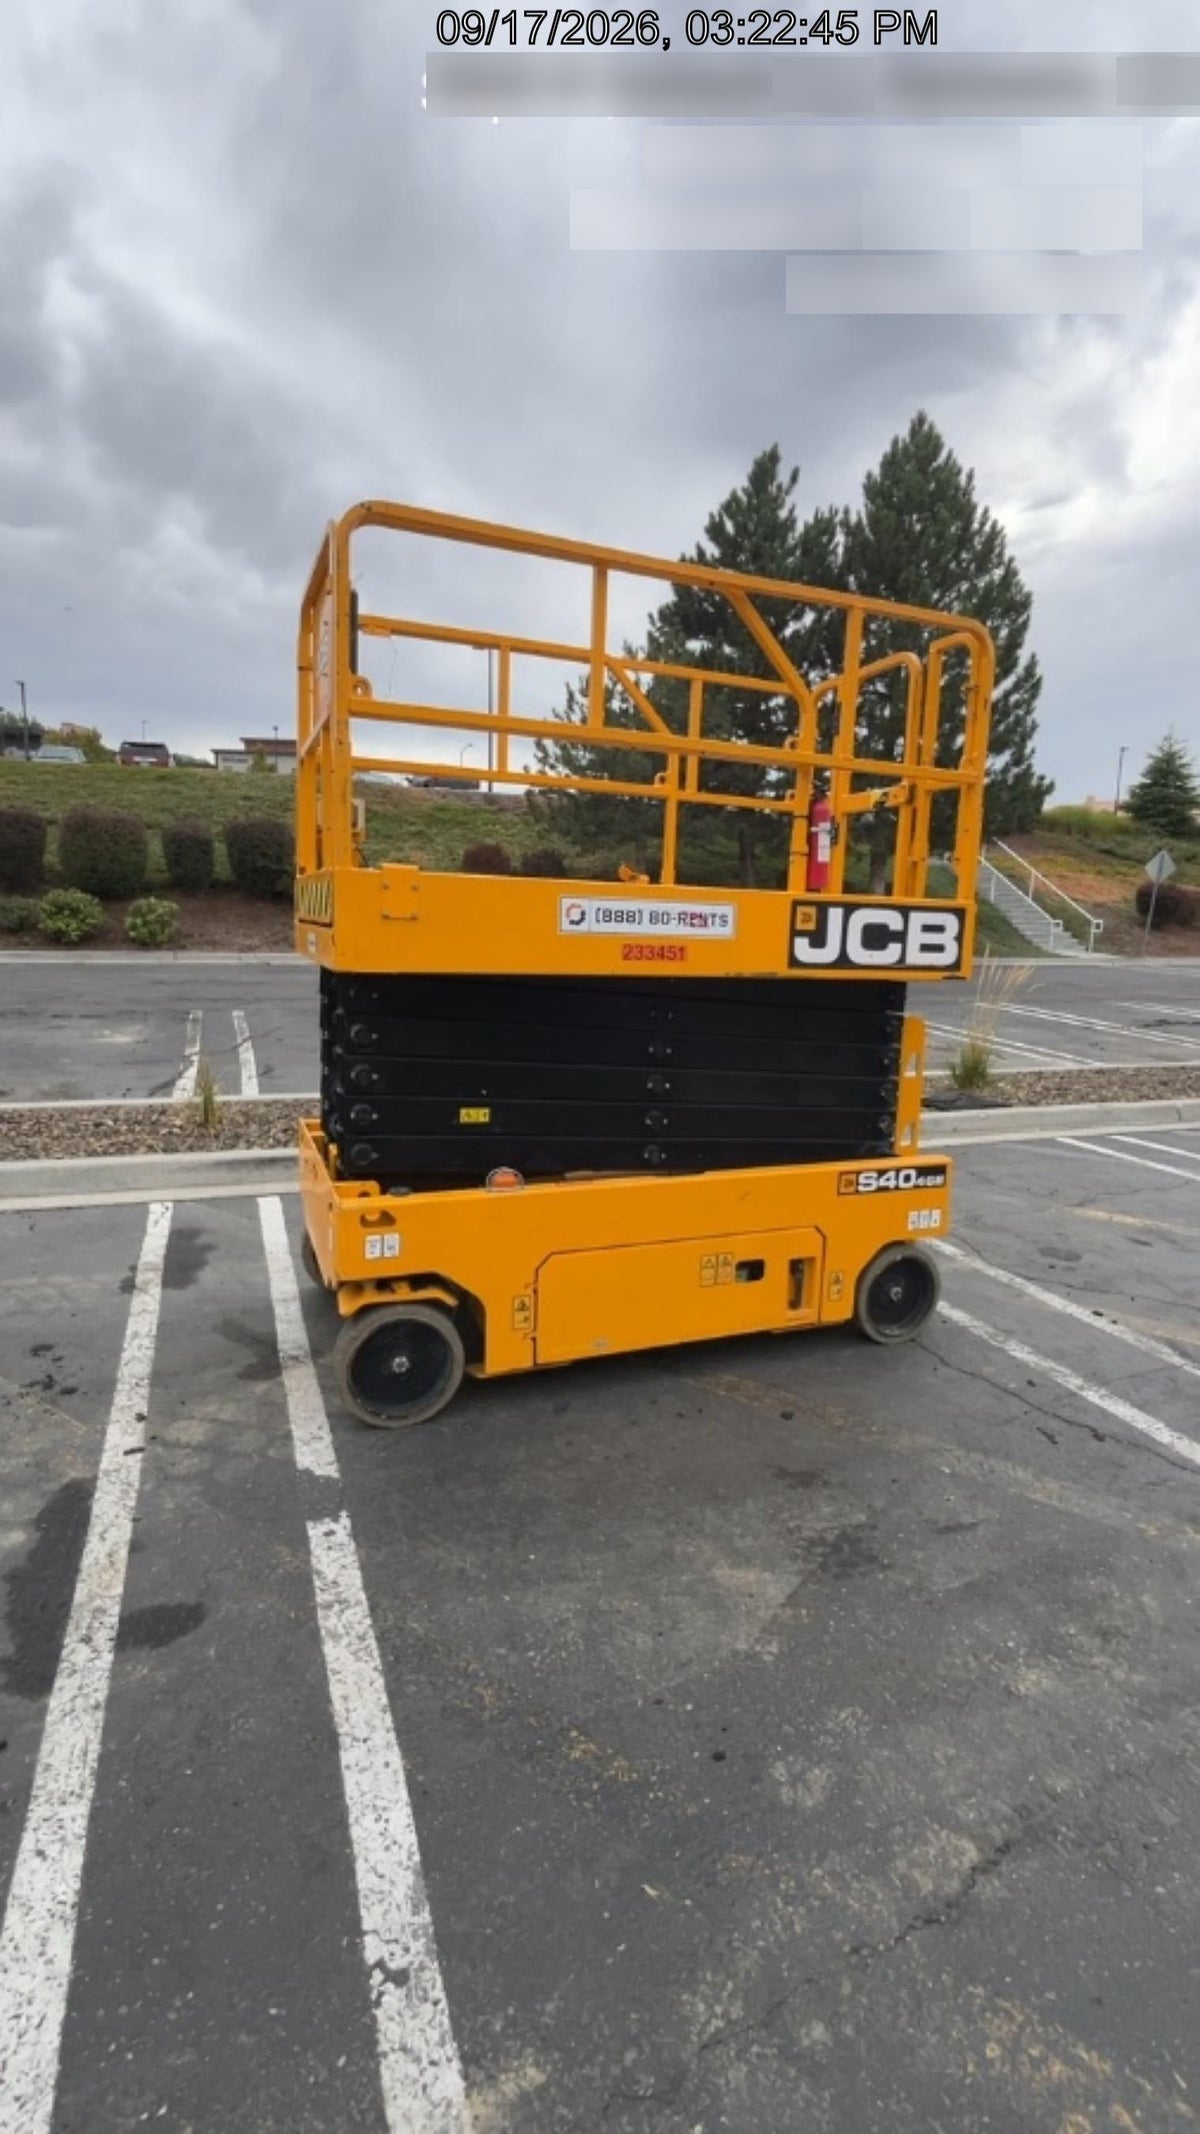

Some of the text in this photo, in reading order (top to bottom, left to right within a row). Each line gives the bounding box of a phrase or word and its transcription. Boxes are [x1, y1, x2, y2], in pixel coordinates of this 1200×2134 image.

[595, 907, 642, 925] (888)
[794, 907, 960, 966] JCB
[622, 943, 686, 961] 233451
